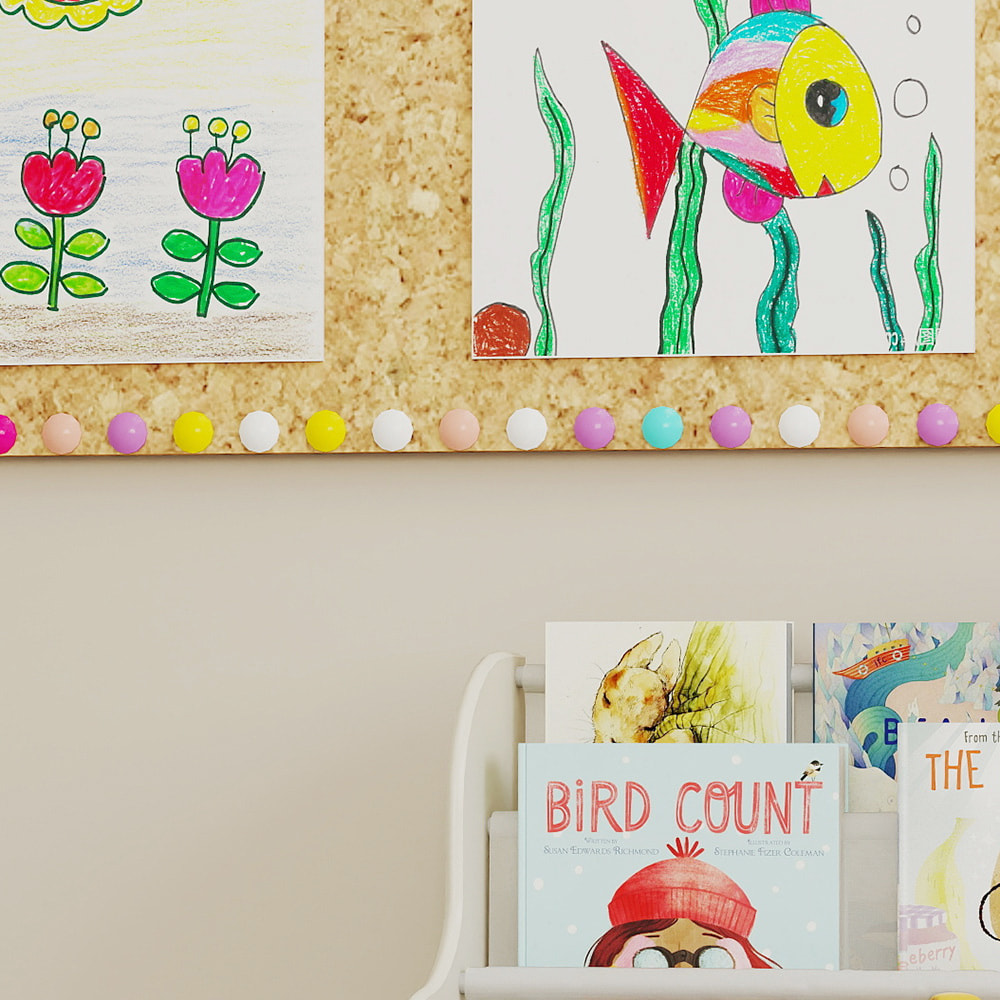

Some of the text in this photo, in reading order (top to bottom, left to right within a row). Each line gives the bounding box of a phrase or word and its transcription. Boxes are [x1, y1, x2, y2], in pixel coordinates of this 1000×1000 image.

[964, 730, 988, 744] From
[925, 750, 984, 791] THE
[675, 780, 824, 835] COUNT
